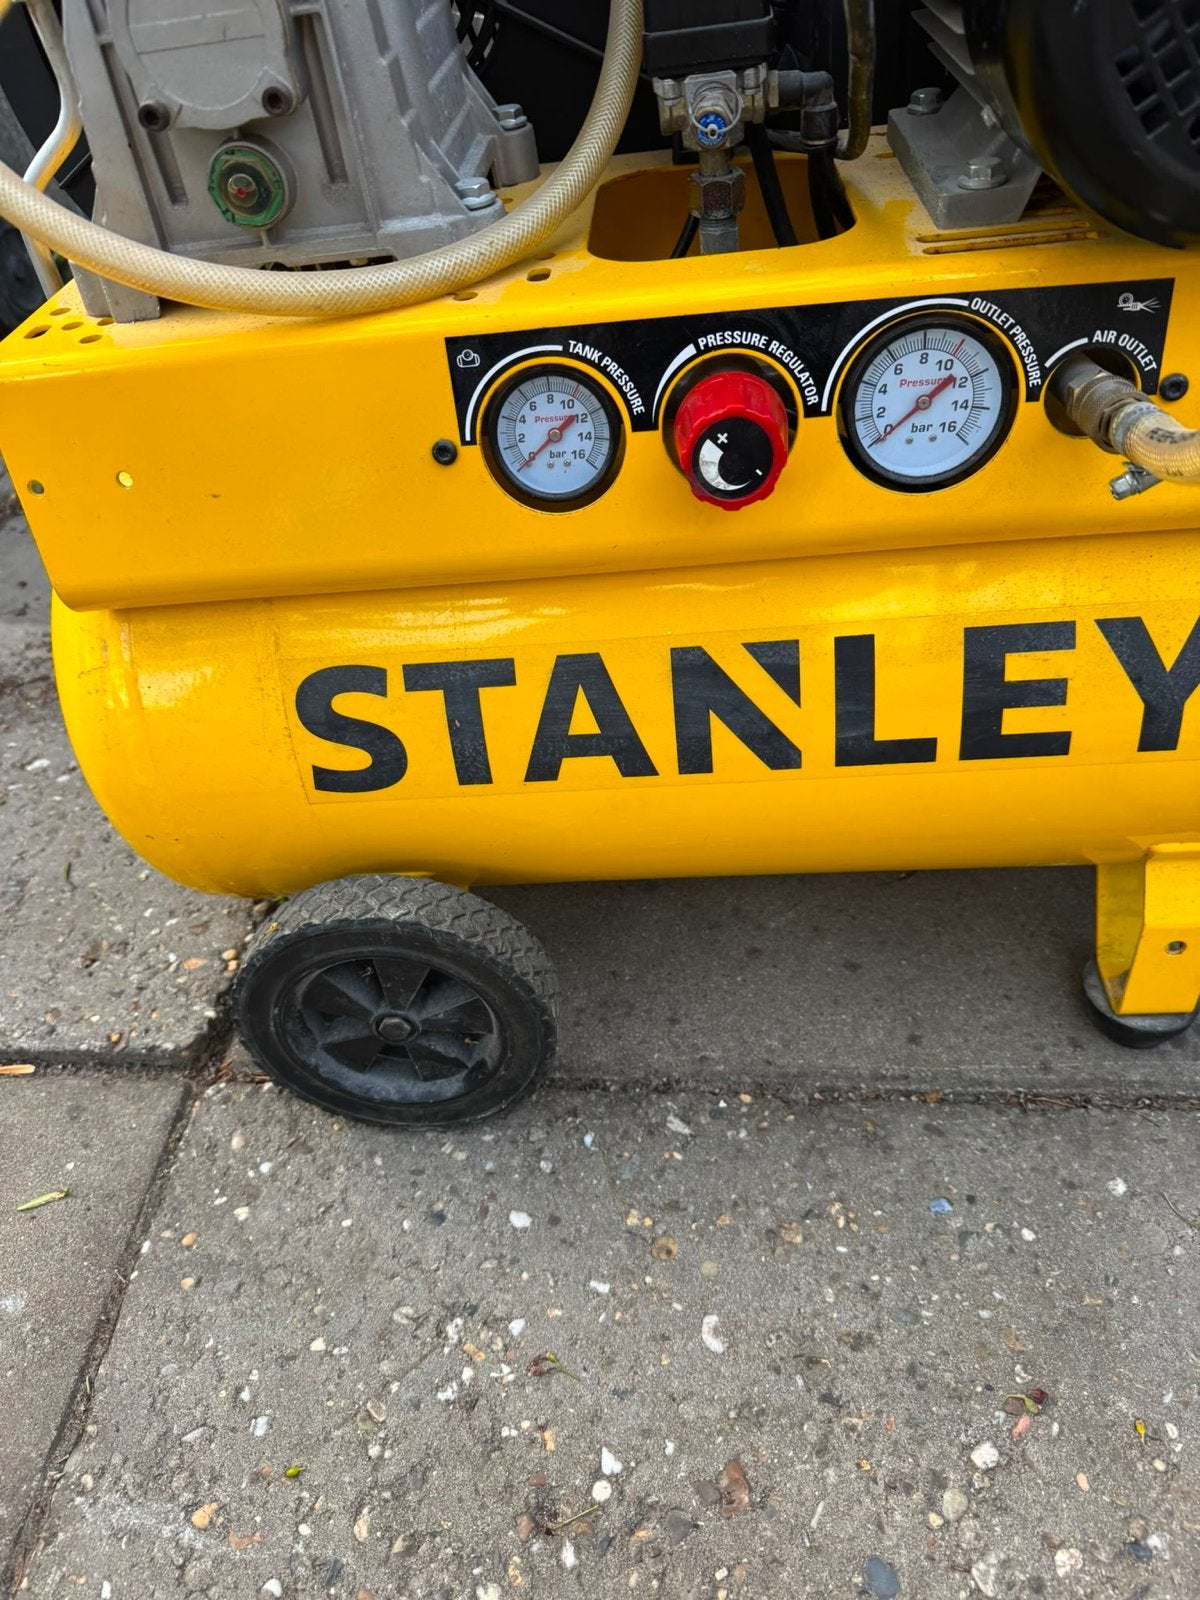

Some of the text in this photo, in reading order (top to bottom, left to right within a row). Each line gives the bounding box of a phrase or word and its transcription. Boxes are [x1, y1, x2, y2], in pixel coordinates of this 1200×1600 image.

[970, 297, 1042, 388] OUTLET PRESSURE
[1092, 329, 1158, 373] AIR OUTLET
[919, 352, 929, 365] 8
[698, 330, 819, 406] PRESSURE REGULATOR
[894, 363, 904, 376] 6
[935, 358, 954, 372] 10
[568, 340, 646, 416] TANK PRESSURE
[899, 377, 948, 388] Pressur
[951, 376, 968, 389] 12
[878, 383, 888, 396] 4
[546, 393, 555, 404] 8
[560, 399, 575, 410] 10
[529, 401, 537, 412] 6
[951, 399, 969, 412] 14
[575, 413, 588, 424] 12
[876, 406, 886, 419] 2
[519, 414, 527, 425] 4
[534, 415, 571, 424] Pressur
[883, 423, 894, 435] 0
[911, 422, 933, 433] bar
[939, 421, 957, 433] 16
[518, 433, 526, 443] 2
[577, 431, 593, 442] 14
[549, 450, 567, 459] bar
[571, 449, 586, 460] 16
[295, 615, 1200, 794] STANLEY
